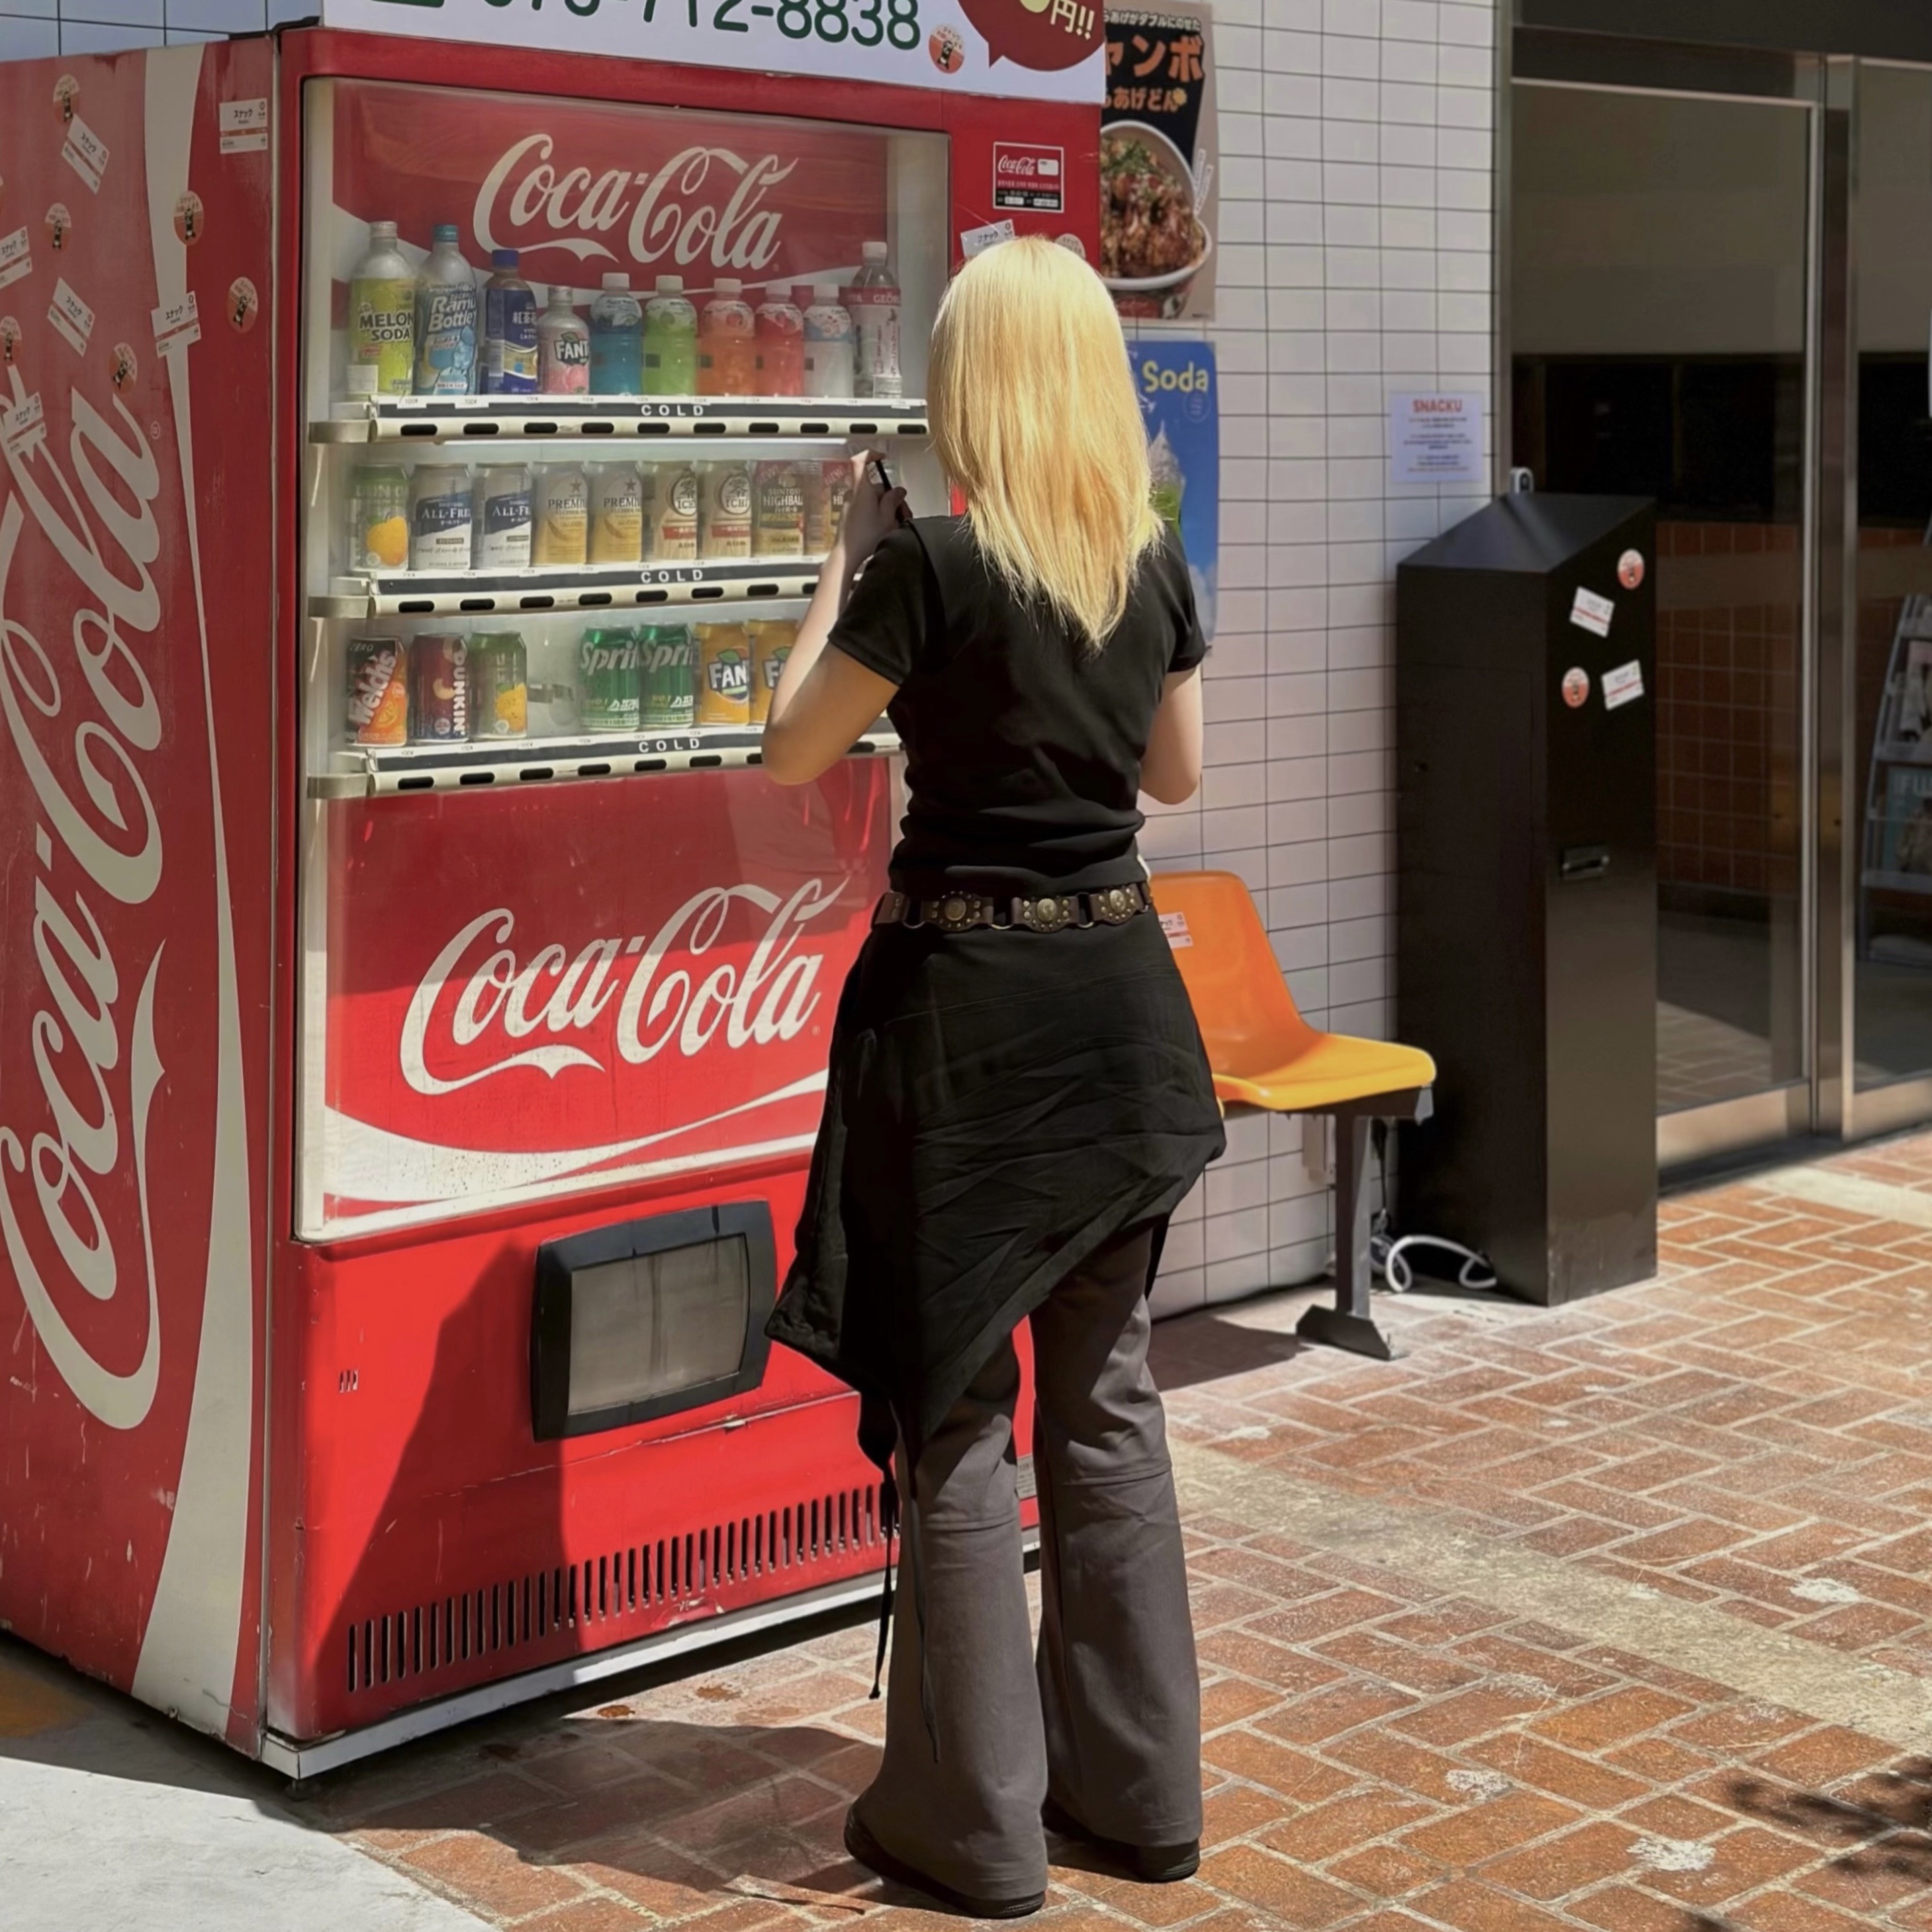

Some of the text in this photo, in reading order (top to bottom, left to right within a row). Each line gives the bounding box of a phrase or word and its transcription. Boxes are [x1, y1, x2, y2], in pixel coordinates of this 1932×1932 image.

[473, 134, 799, 271] Coca-Cola
[1142, 360, 1208, 392] Soda
[641, 404, 704, 416] COLD
[640, 569, 703, 584] COLD
[638, 737, 700, 753] COLD
[400, 876, 851, 1095] Coca-Cola
